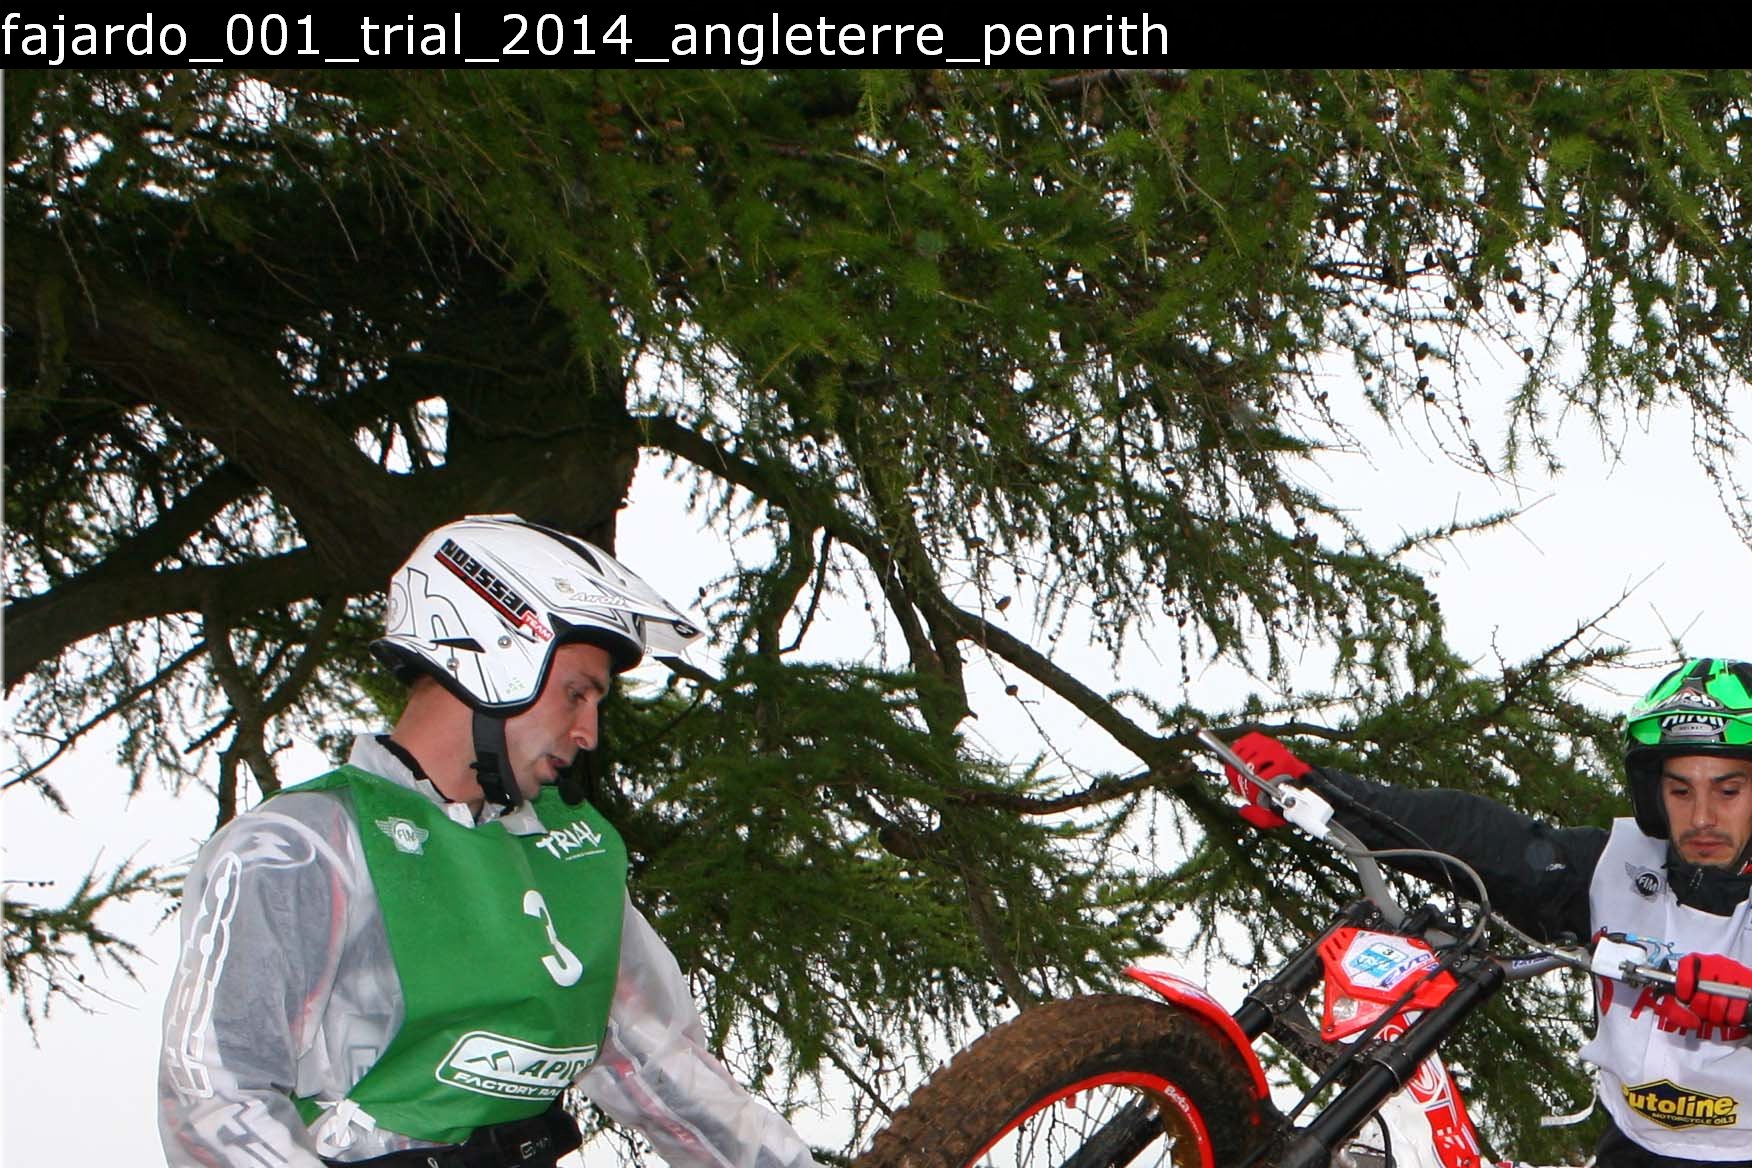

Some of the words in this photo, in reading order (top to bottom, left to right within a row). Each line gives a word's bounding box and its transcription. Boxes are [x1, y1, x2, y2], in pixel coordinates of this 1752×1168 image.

[536, 820, 602, 860] TRIAL
[522, 889, 585, 988] 3
[453, 1071, 537, 1096] FACTORY
